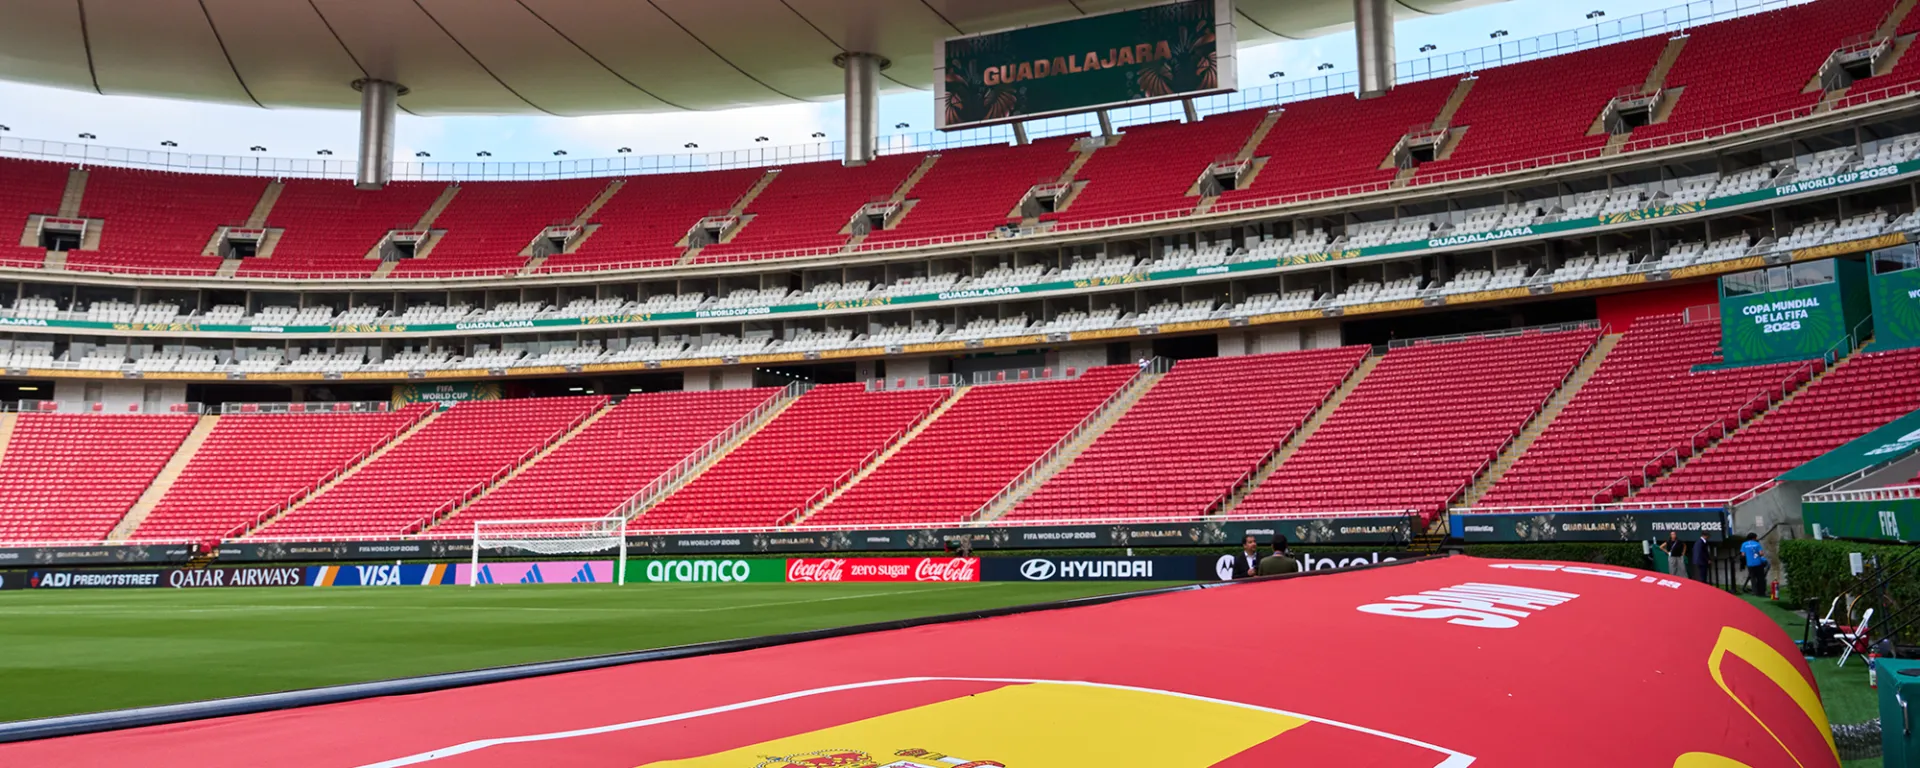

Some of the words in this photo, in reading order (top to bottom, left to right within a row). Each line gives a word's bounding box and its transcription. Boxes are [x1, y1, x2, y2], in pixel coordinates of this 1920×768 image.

[983, 41, 1172, 86] GUADALAJARA
[1776, 183, 1798, 196] FIFA
[1799, 177, 1836, 191] WORLD
[1837, 172, 1859, 184] CUP
[1859, 165, 1899, 180] 2026
[1428, 226, 1533, 248] GUADALAJARA
[938, 286, 1021, 300] GUADALAJARA
[711, 309, 734, 317] WORLD
[747, 307, 770, 315] 2026
[1742, 303, 1771, 316] COPA
[1772, 297, 1820, 312] MUNDIAL
[1755, 314, 1769, 324] DE
[1769, 312, 1783, 322] LA
[1785, 309, 1808, 321] FIFA
[456, 320, 534, 330] GUADALAJARA
[1763, 321, 1801, 333] 2026
[422, 392, 451, 400] WORLD
[451, 392, 468, 400] CUP
[436, 384, 454, 393] FIFA
[1340, 526, 1399, 535] GUADALAJARA
[1562, 522, 1616, 532] GUADALAJARA
[1651, 522, 1665, 531] FIFA
[1665, 522, 1687, 531] WORLD
[1688, 522, 1700, 531] CUP
[1878, 511, 1898, 536] FIFA
[1037, 532, 1060, 540] WORLD
[1074, 531, 1097, 539] 2026
[1131, 529, 1182, 539] GUADALAJARA
[355, 565, 401, 586] VISA
[646, 560, 750, 582] aramco
[788, 558, 846, 582] Coca-Cola
[851, 564, 875, 576] zero
[877, 563, 911, 579] sugar
[915, 557, 978, 582] Coca-Cola
[1060, 560, 1153, 578] HYUNDAI
[40, 573, 71, 587] ADI
[73, 574, 159, 586] PREDICTSTREET
[169, 569, 224, 589] QATAR
[229, 567, 300, 587] AIRWAYS
[1356, 582, 1580, 629] SPAIN
